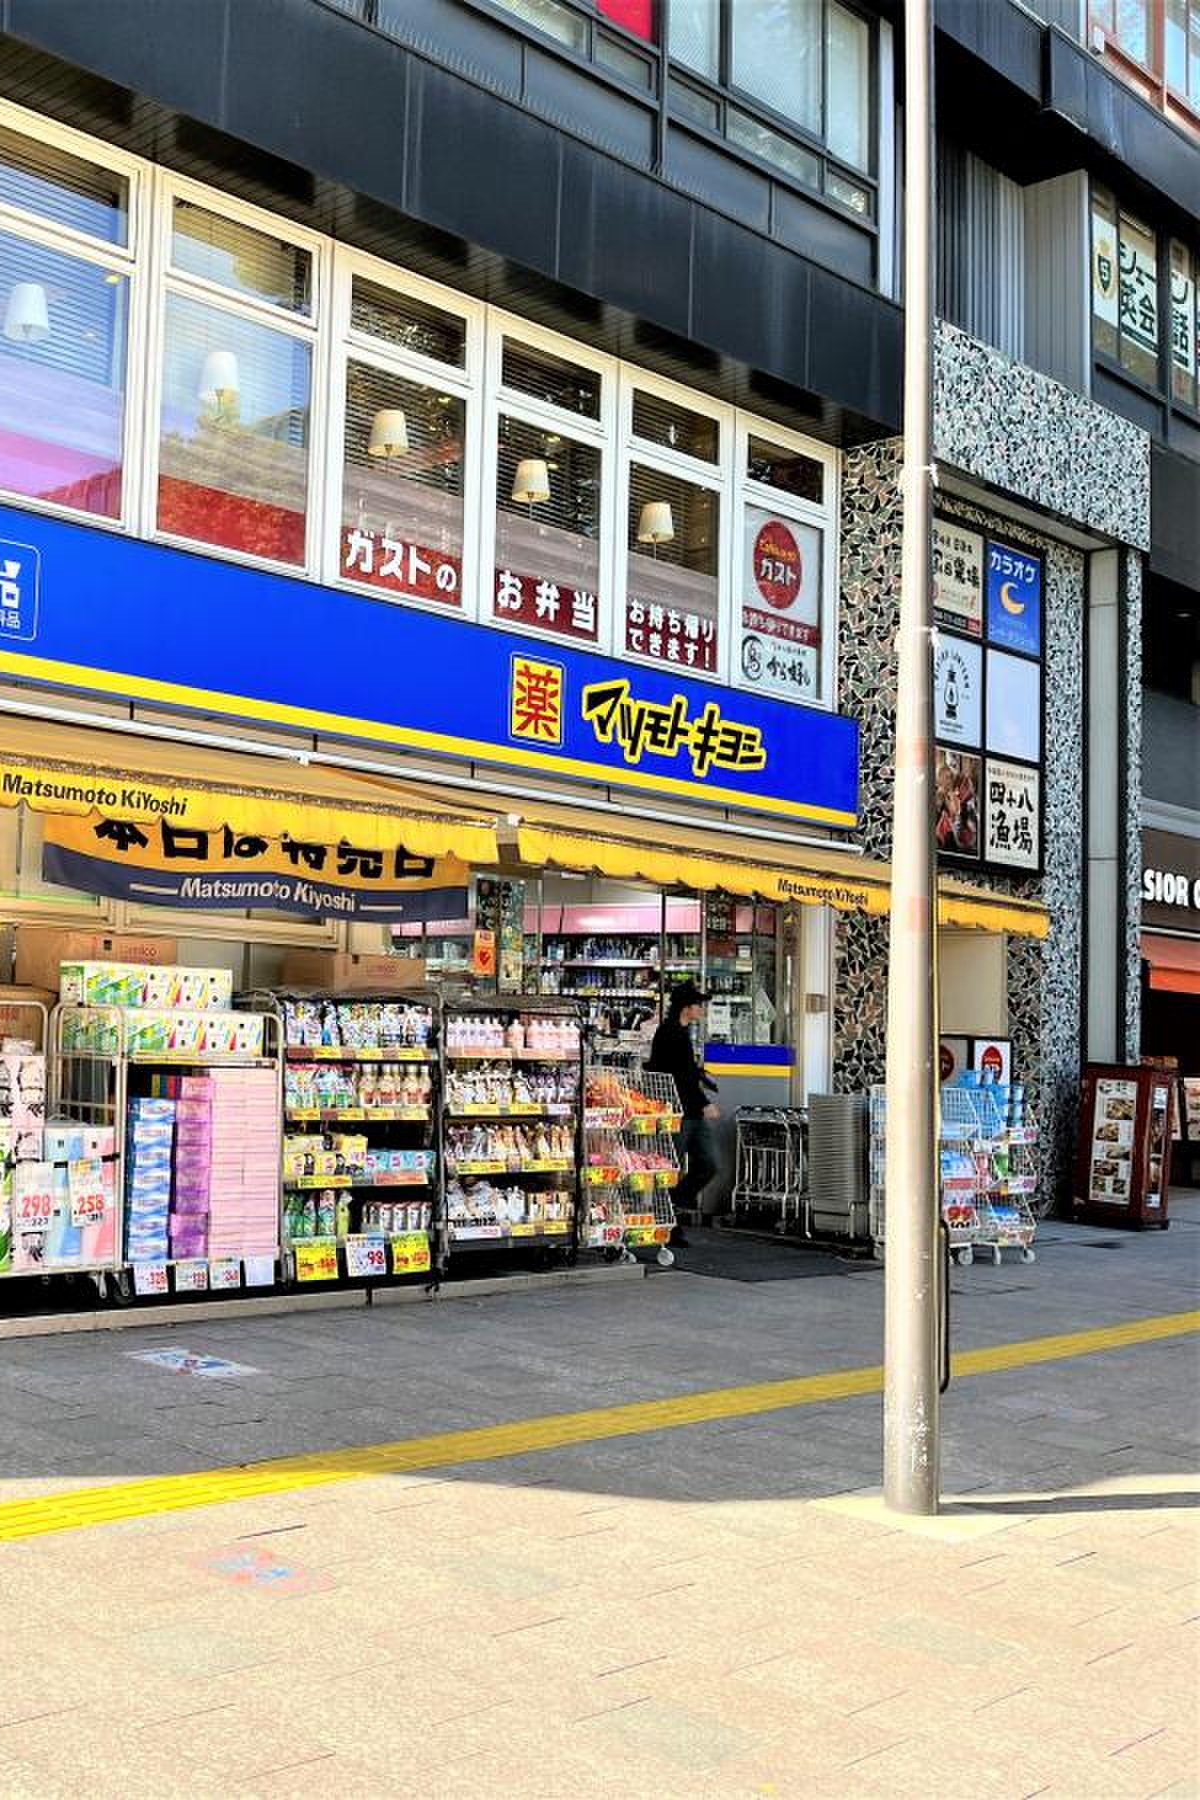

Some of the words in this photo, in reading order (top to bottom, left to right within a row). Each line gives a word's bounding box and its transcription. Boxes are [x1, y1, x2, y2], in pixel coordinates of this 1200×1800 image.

[346, 529, 457, 592] ガストの
[761, 558, 797, 586] ガスト
[990, 551, 1036, 583] カラオケ
[496, 572, 598, 633] お弁当
[628, 599, 714, 642] お持ち帰り
[628, 627, 712, 669] できます！
[515, 663, 560, 740] 薬
[584, 683, 764, 772] マツモトキヨシ
[1, 773, 117, 806] Matsumoto
[990, 780, 1034, 813] 四十八
[990, 809, 1034, 854] 漁場
[179, 877, 290, 901] Matsumoto
[294, 885, 356, 912] Kiyoshi
[1140, 868, 1189, 907] SIOR
